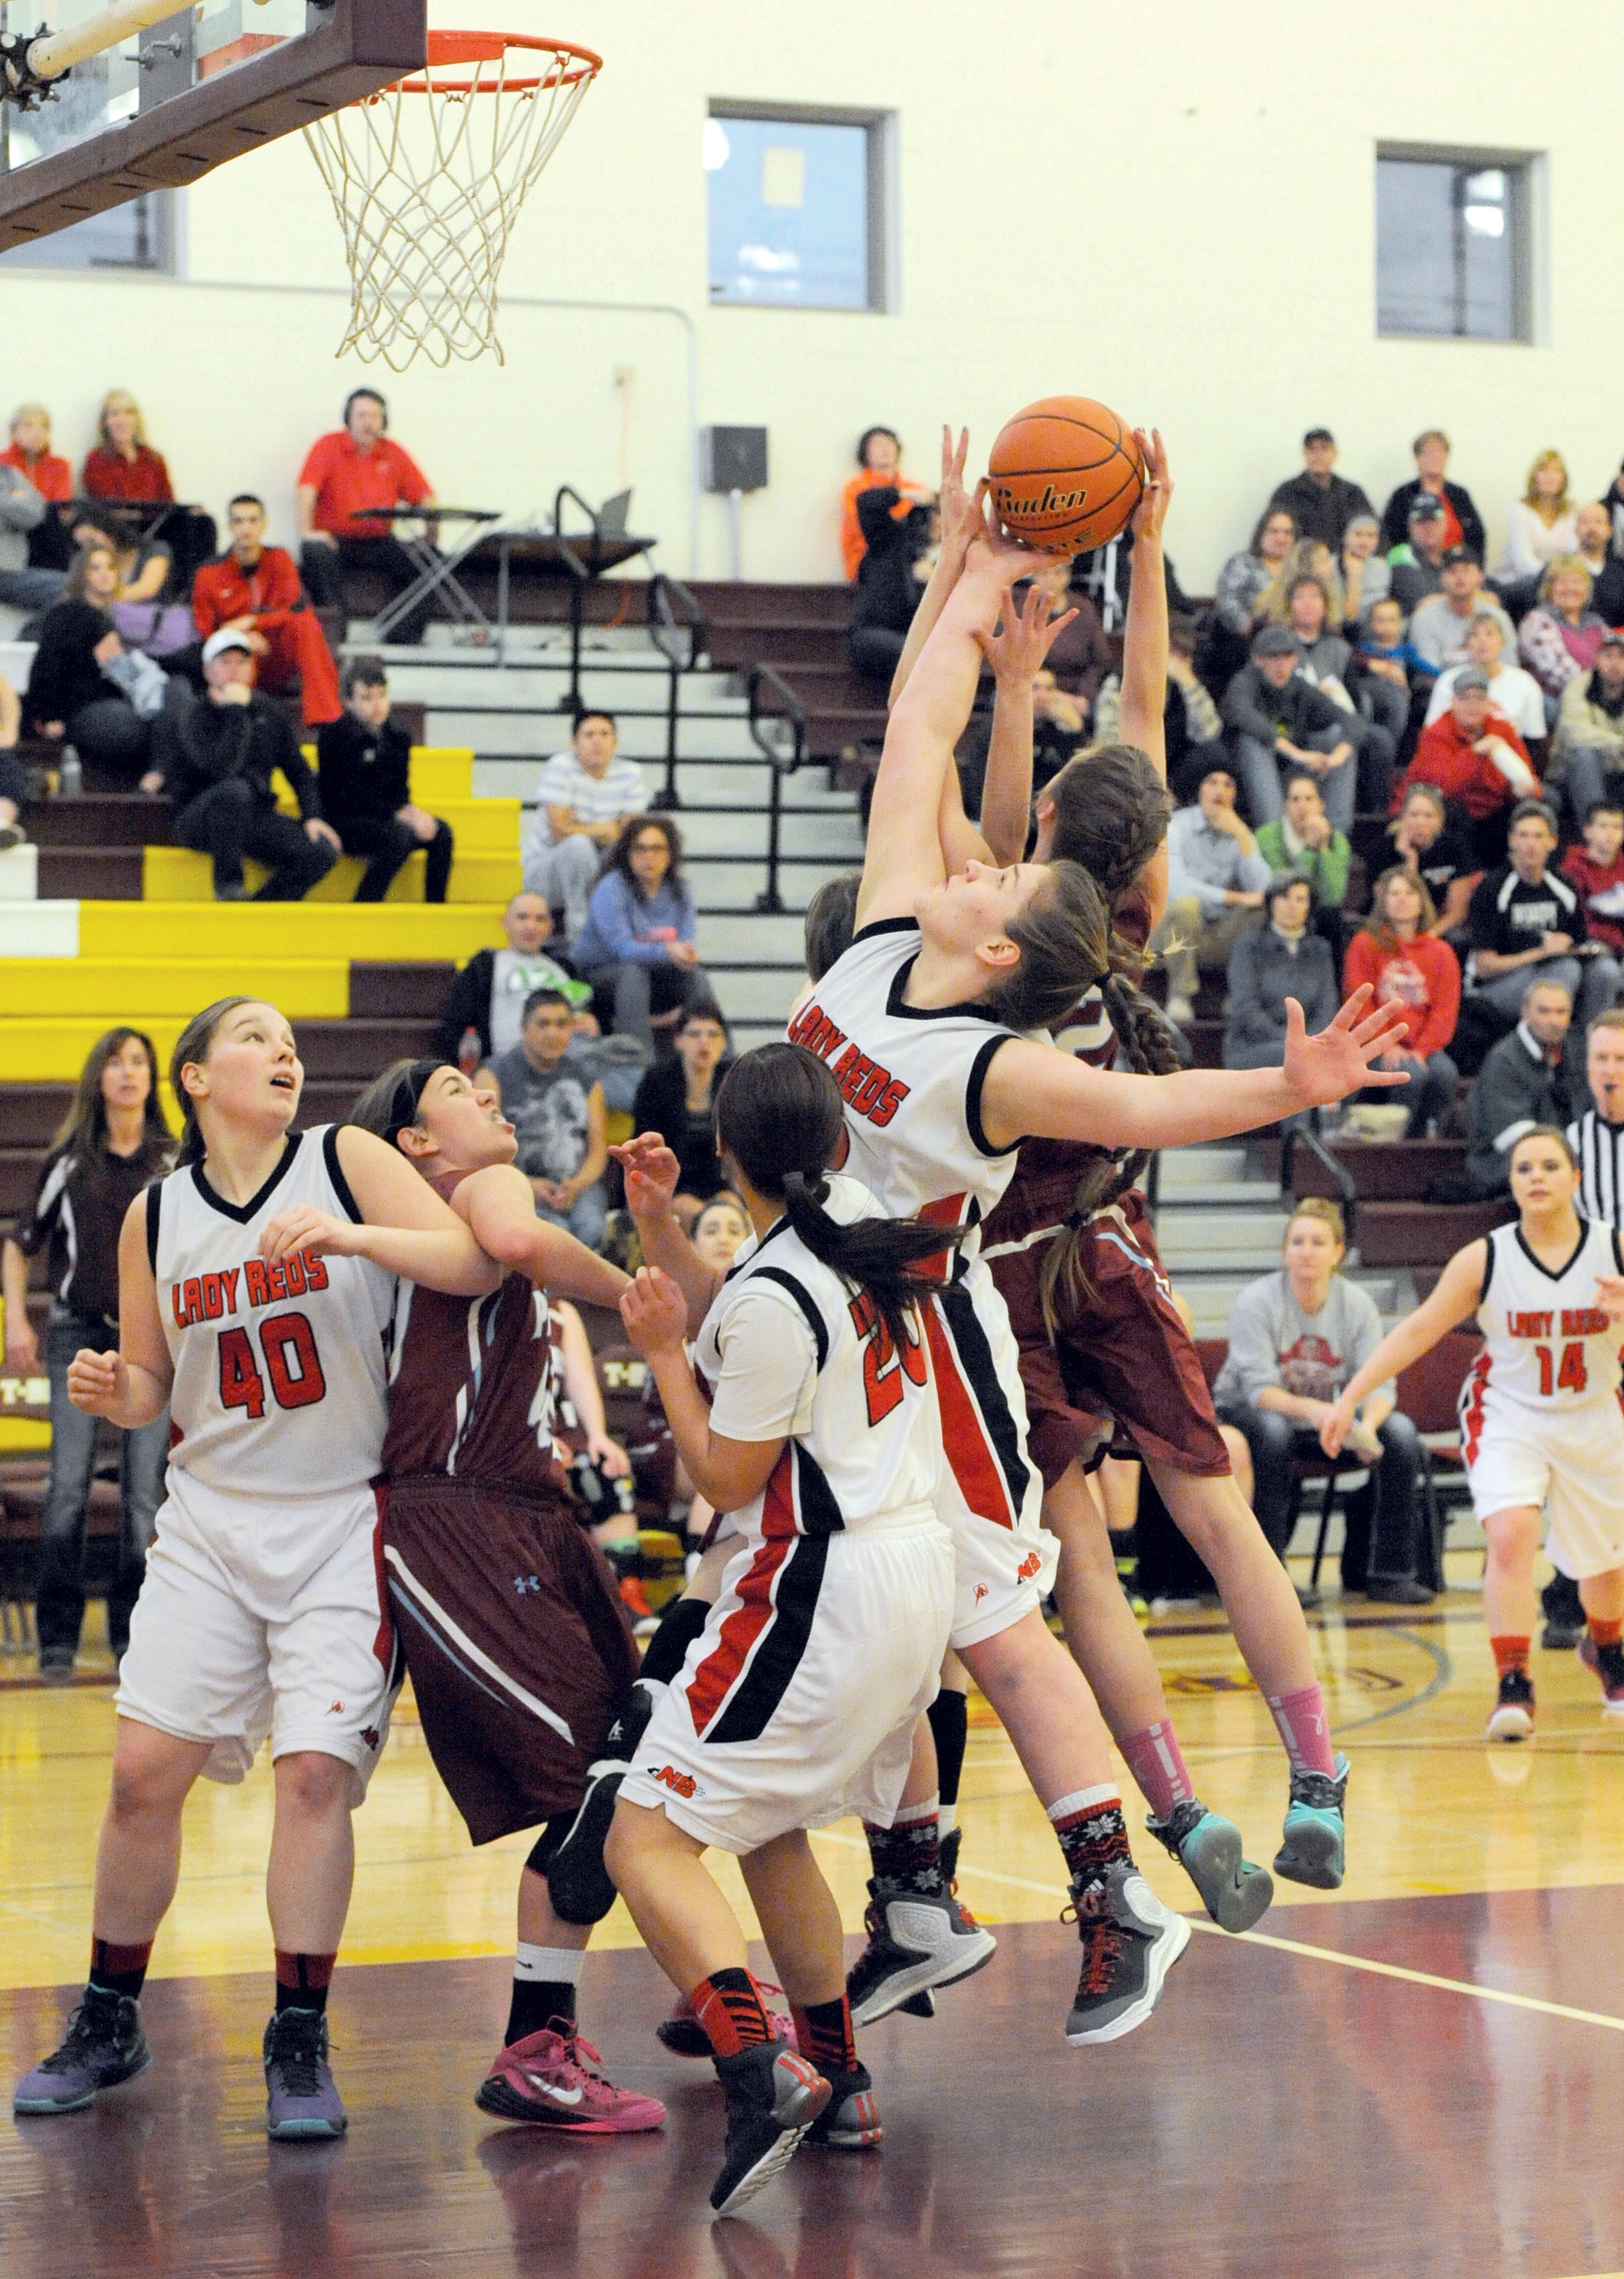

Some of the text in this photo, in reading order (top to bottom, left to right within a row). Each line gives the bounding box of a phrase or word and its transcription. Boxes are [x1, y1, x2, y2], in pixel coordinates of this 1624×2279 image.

[996, 484, 1088, 515] Baden
[831, 1042, 912, 1128] REDS
[171, 1249, 330, 1330] LADY REDS
[217, 1310, 327, 1420] 40
[1535, 1342, 1588, 1397] 14
[655, 1765, 697, 1799] NB
